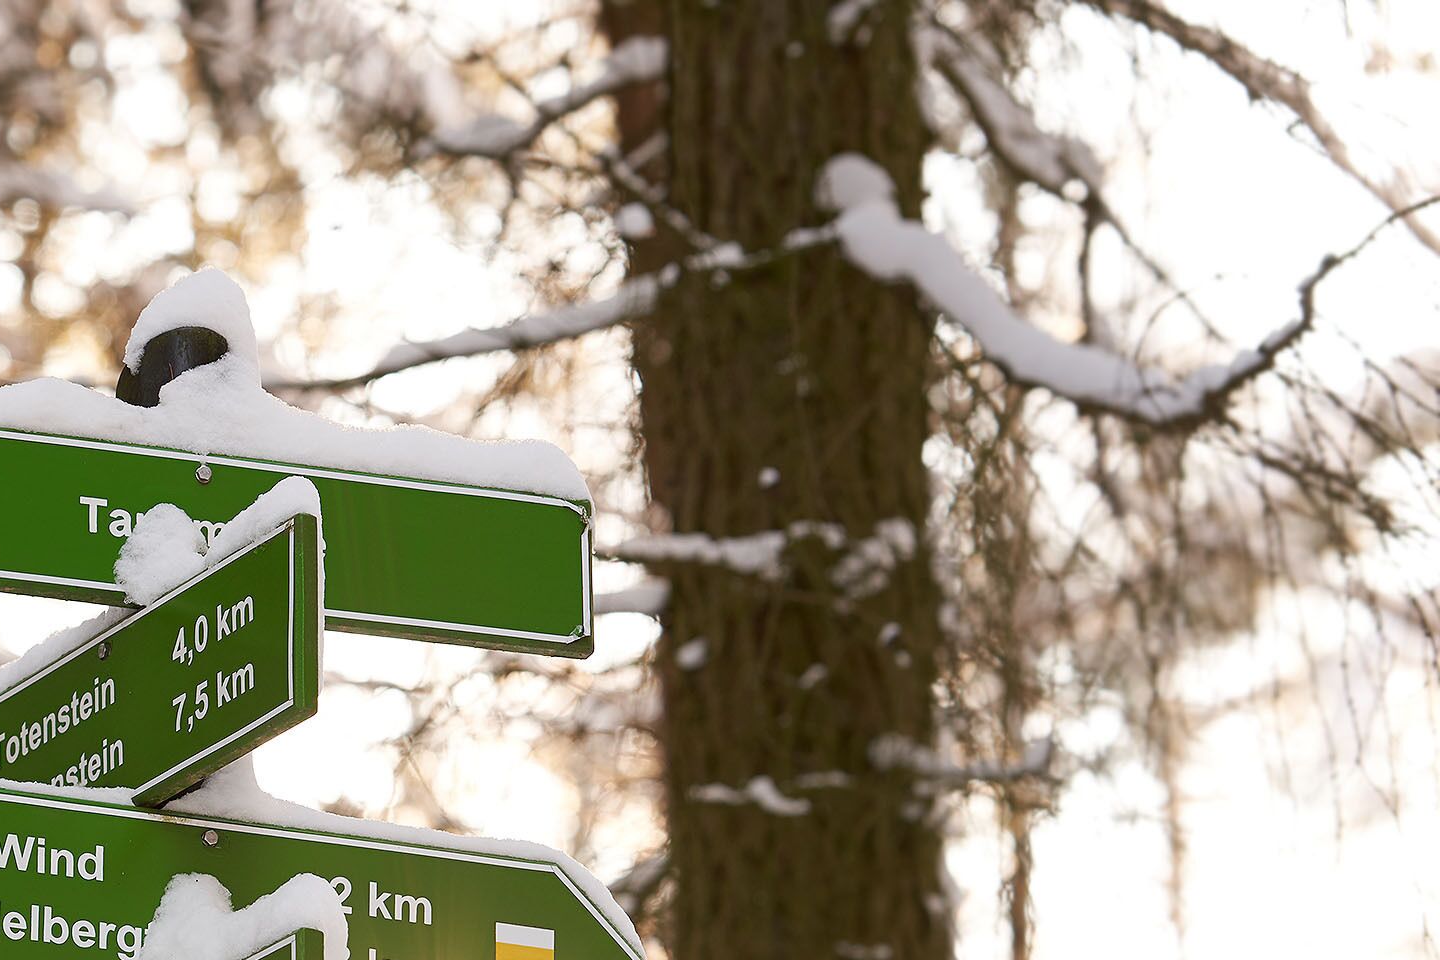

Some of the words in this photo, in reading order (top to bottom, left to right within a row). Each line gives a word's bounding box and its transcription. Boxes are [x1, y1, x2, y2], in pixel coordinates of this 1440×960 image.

[172, 615, 208, 666] 4,0
[217, 594, 254, 642] km
[51, 738, 124, 787] nstein
[172, 680, 209, 733] 7,5
[217, 663, 255, 708] km
[368, 881, 432, 926] km
